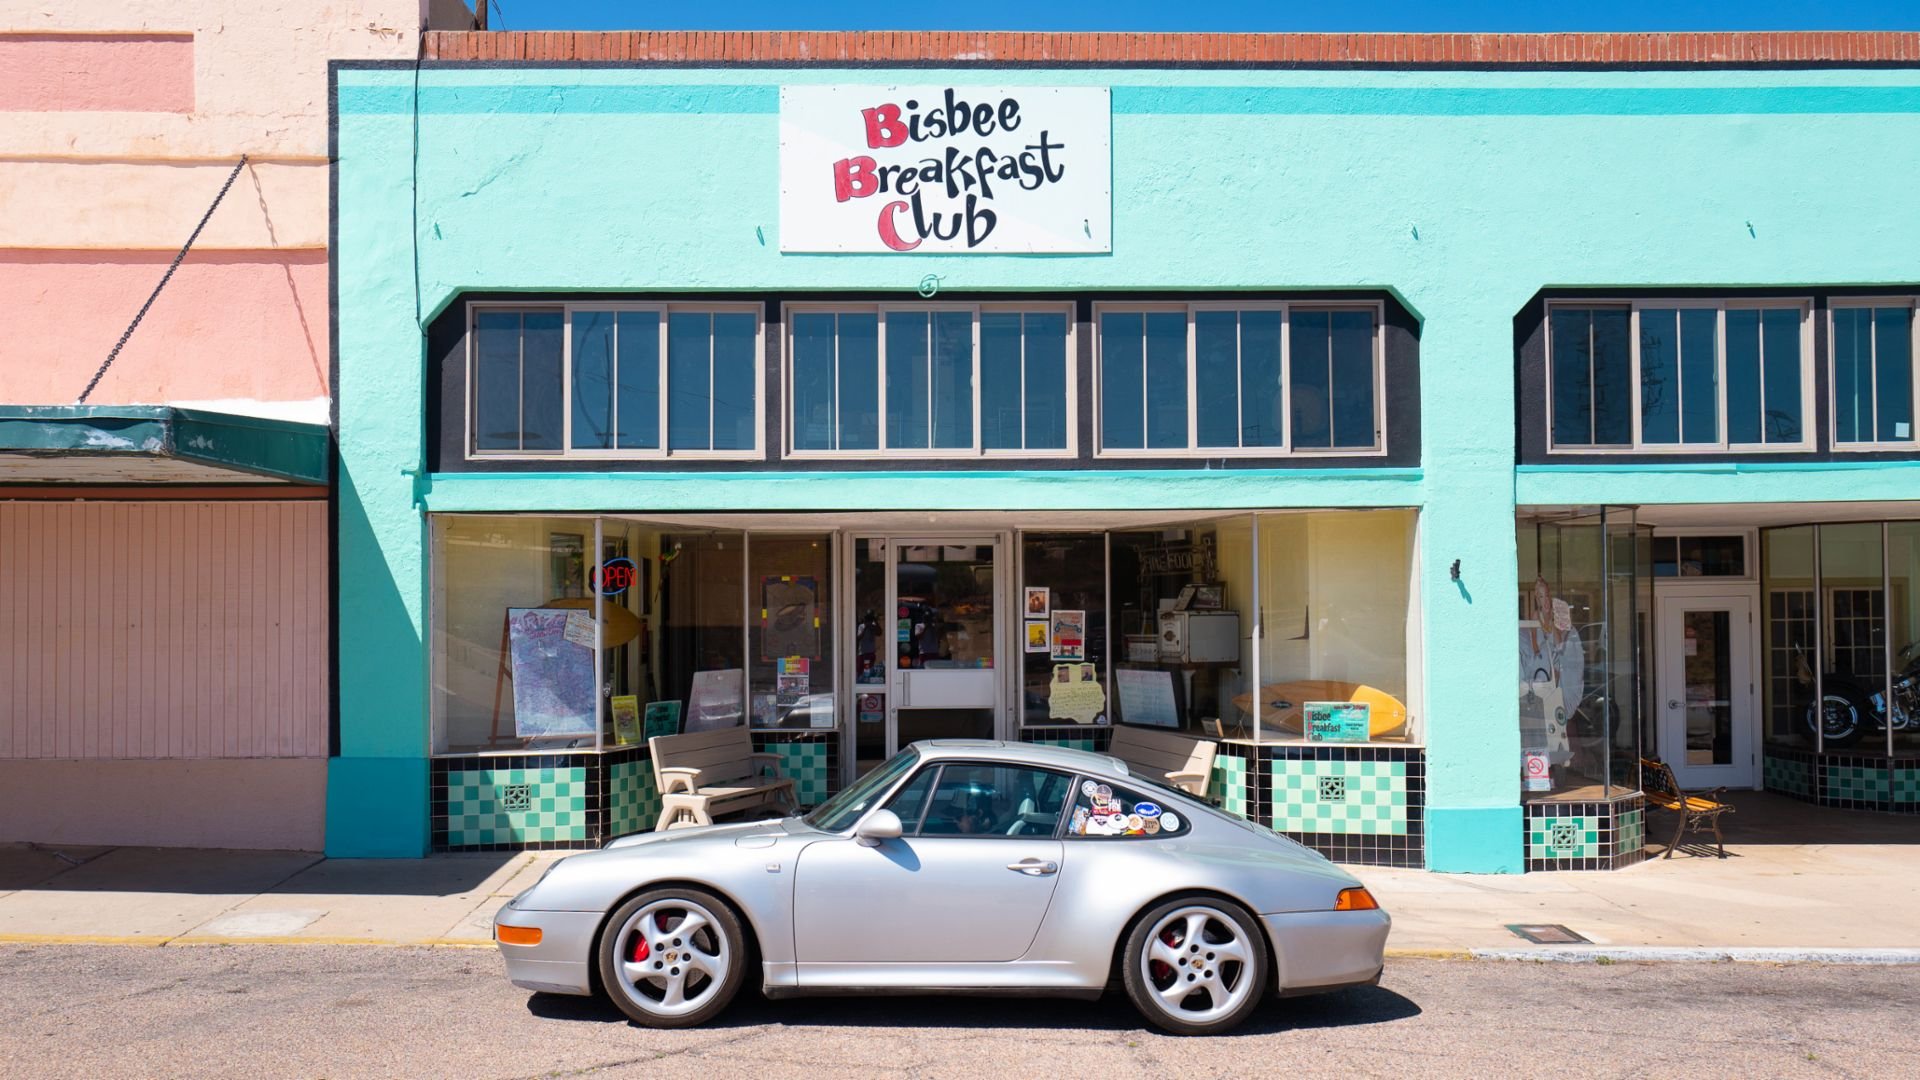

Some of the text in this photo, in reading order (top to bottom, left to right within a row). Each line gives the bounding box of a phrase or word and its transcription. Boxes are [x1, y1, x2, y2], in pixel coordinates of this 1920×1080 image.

[861, 88, 1021, 149] Bisbee
[833, 130, 1065, 203] Breakfast
[877, 188, 997, 251] Club
[593, 566, 637, 588] OPEN
